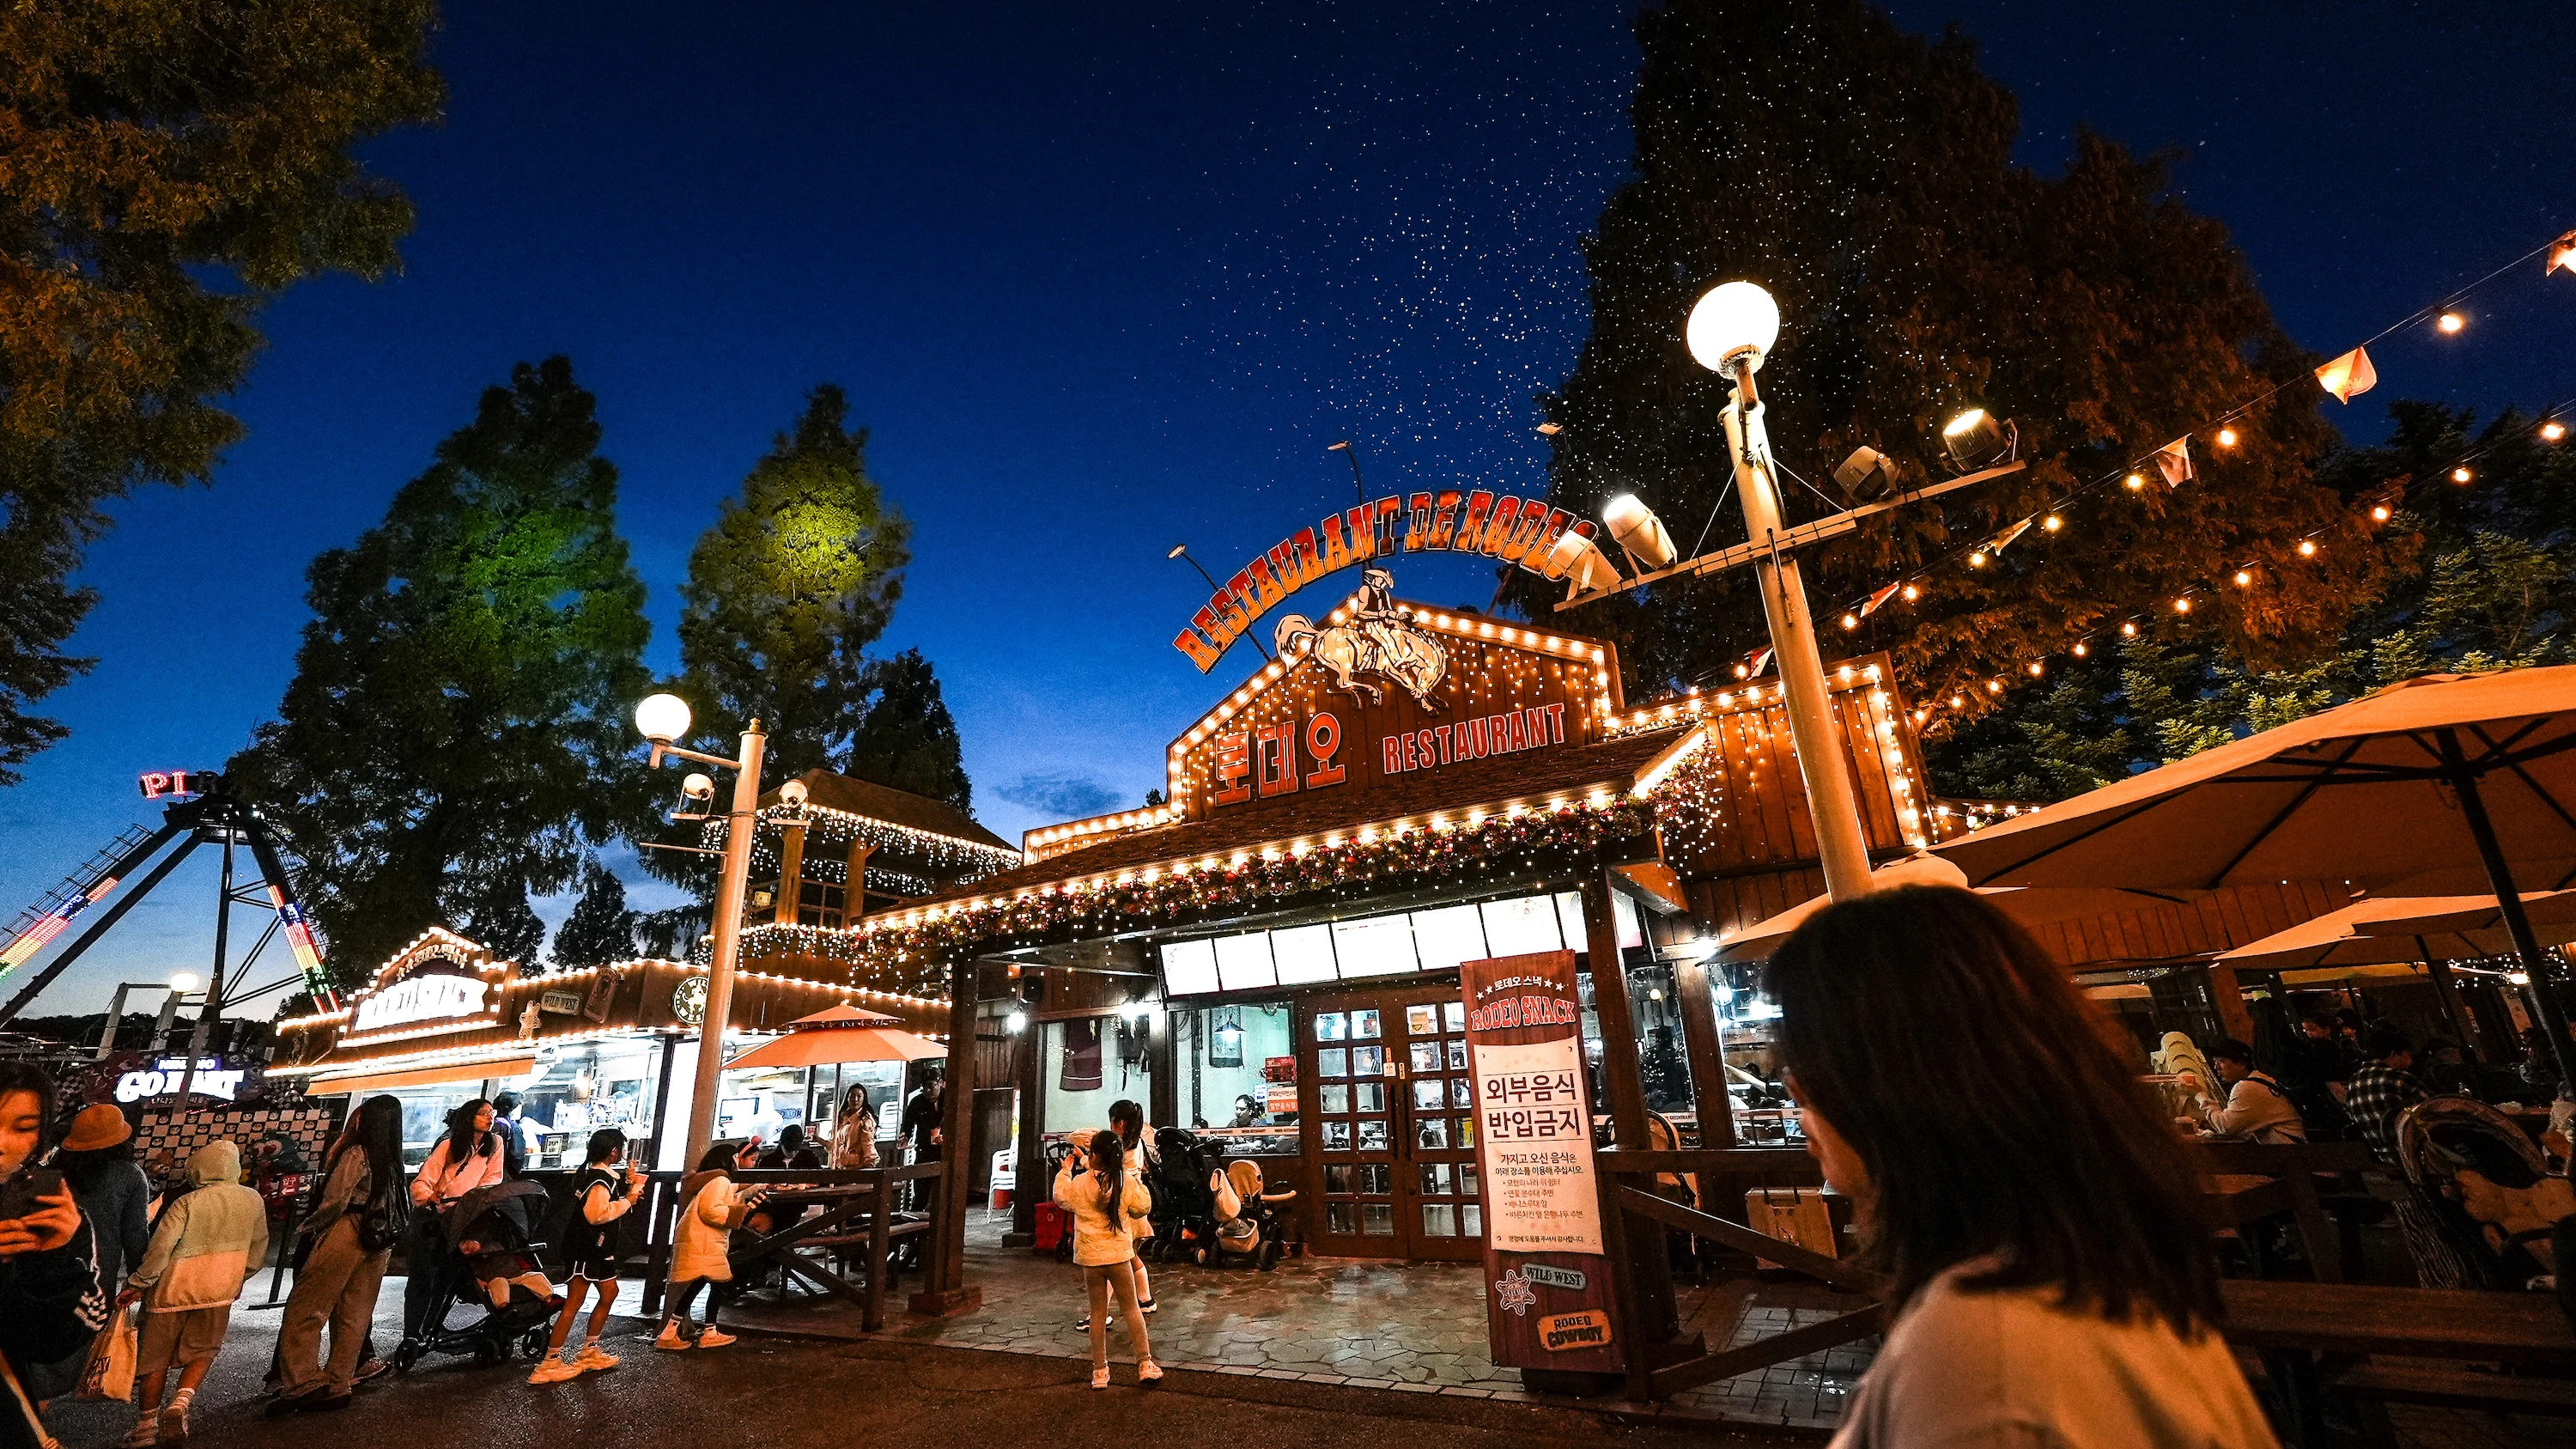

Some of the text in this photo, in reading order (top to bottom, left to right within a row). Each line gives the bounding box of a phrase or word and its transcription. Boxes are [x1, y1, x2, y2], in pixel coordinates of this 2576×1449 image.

[1172, 495, 1400, 675] RESTAURANT
[1403, 490, 1462, 553] DE
[1384, 703, 1565, 775] RESTAURANT
[1215, 712, 1346, 807] 로데오
[1494, 976, 1542, 991] 로데오 스낵
[1471, 995, 1576, 1031] RODEO SNACK
[1486, 1073, 1576, 1103] 외부음식
[1488, 1108, 1581, 1138] 반입금지
[1501, 1152, 1577, 1165] 가지고 오신 음식은
[1510, 1167, 1531, 1176] 장소를
[1532, 1166, 1553, 1176] 이용해
[1527, 1267, 1583, 1286] WILD WEST
[1553, 1315, 1592, 1330] RODEO
